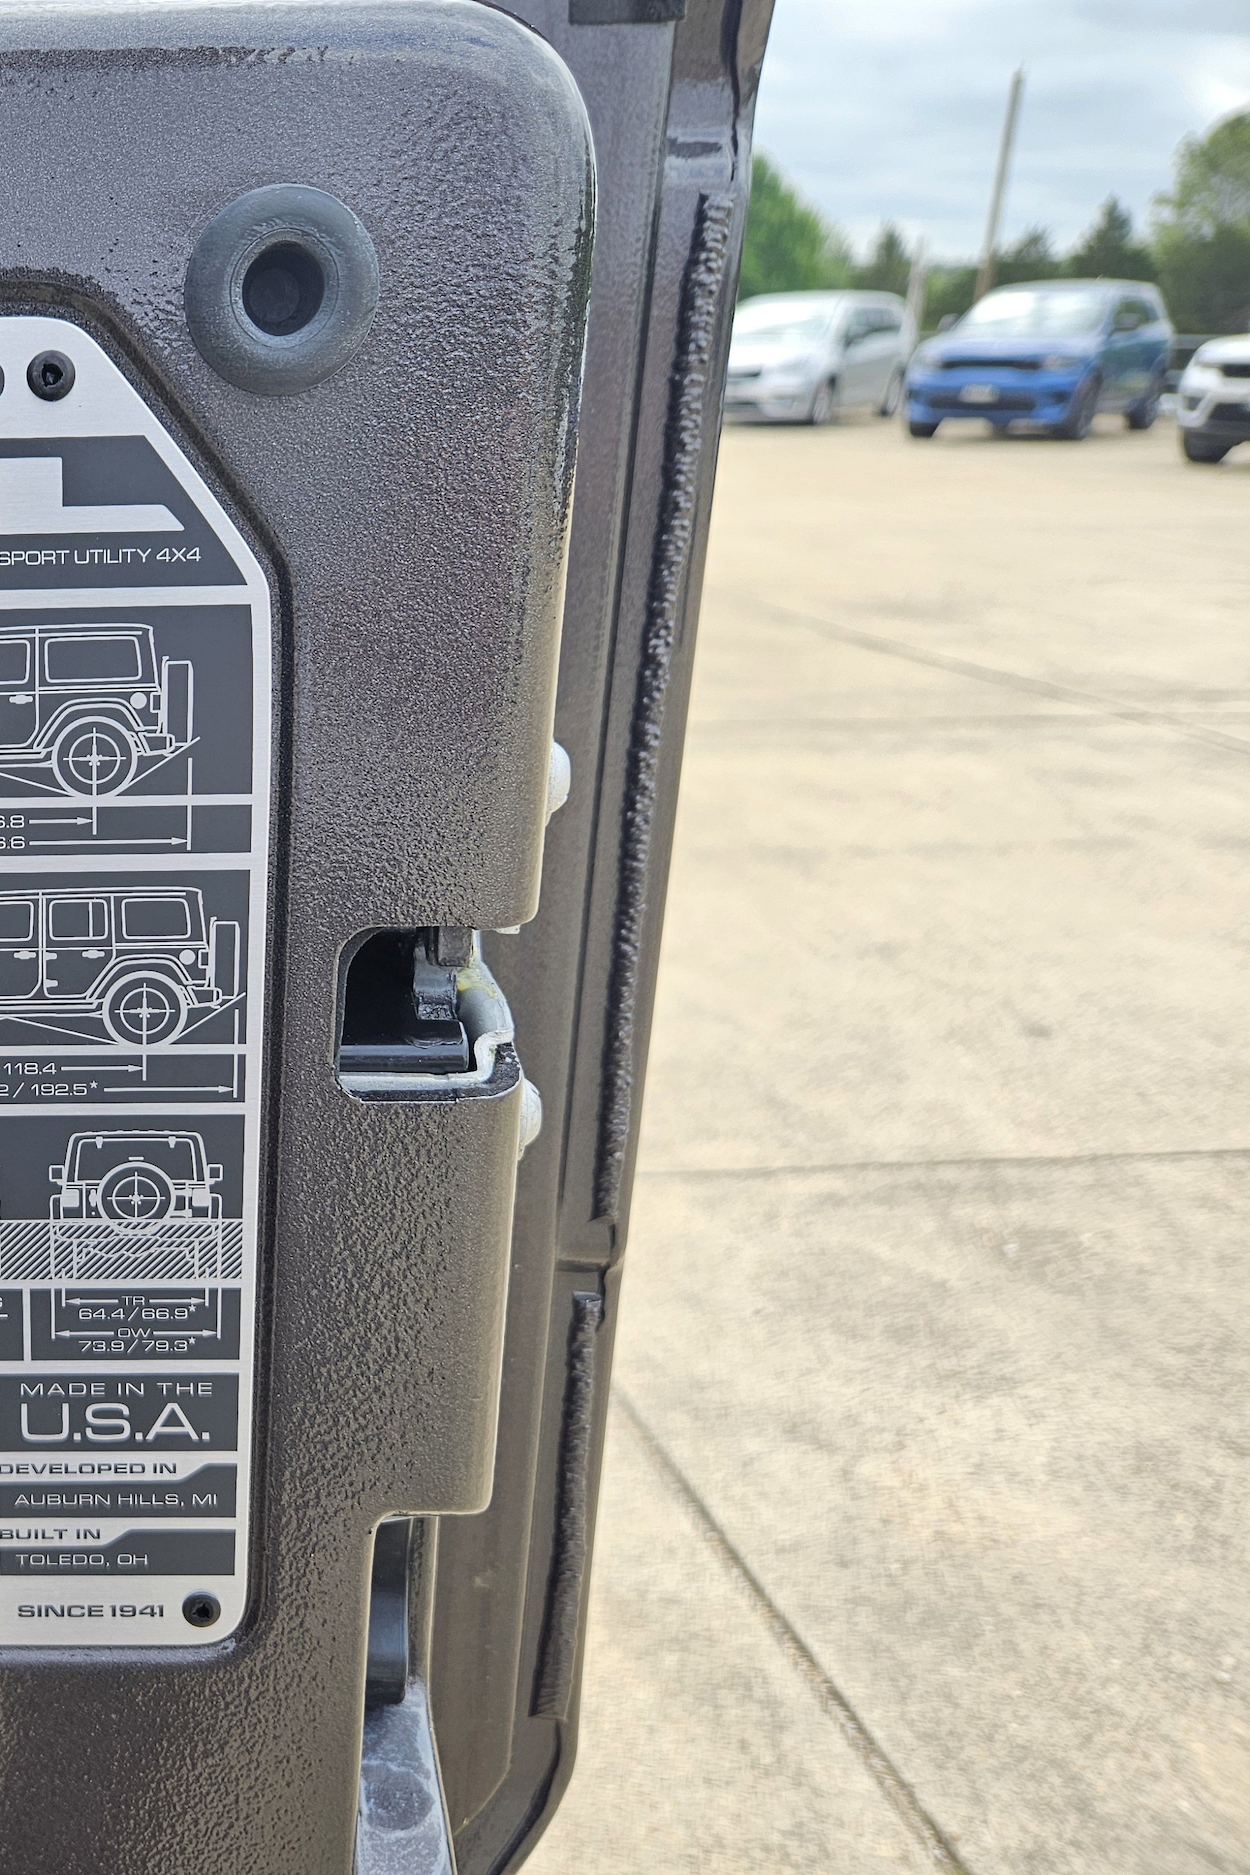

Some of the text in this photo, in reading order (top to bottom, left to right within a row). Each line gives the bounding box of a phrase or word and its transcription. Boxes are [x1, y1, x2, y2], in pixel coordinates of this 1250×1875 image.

[74, 548, 151, 565] UTILITY
[155, 546, 202, 563] 4X4
[2, 1062, 57, 1076] 118.4
[121, 1295, 146, 1307] TR
[116, 1327, 151, 1339] OW
[19, 1381, 214, 1397] MADE IN THE
[20, 1401, 211, 1443] U.S.A.
[151, 1462, 177, 1475] IN
[14, 1493, 218, 1508] AUBURN HILLS, MI
[0, 1528, 101, 1541] BUILT IN
[15, 1553, 148, 1567] TOLEDO, OH
[17, 1604, 165, 1618] SINCE 1941
